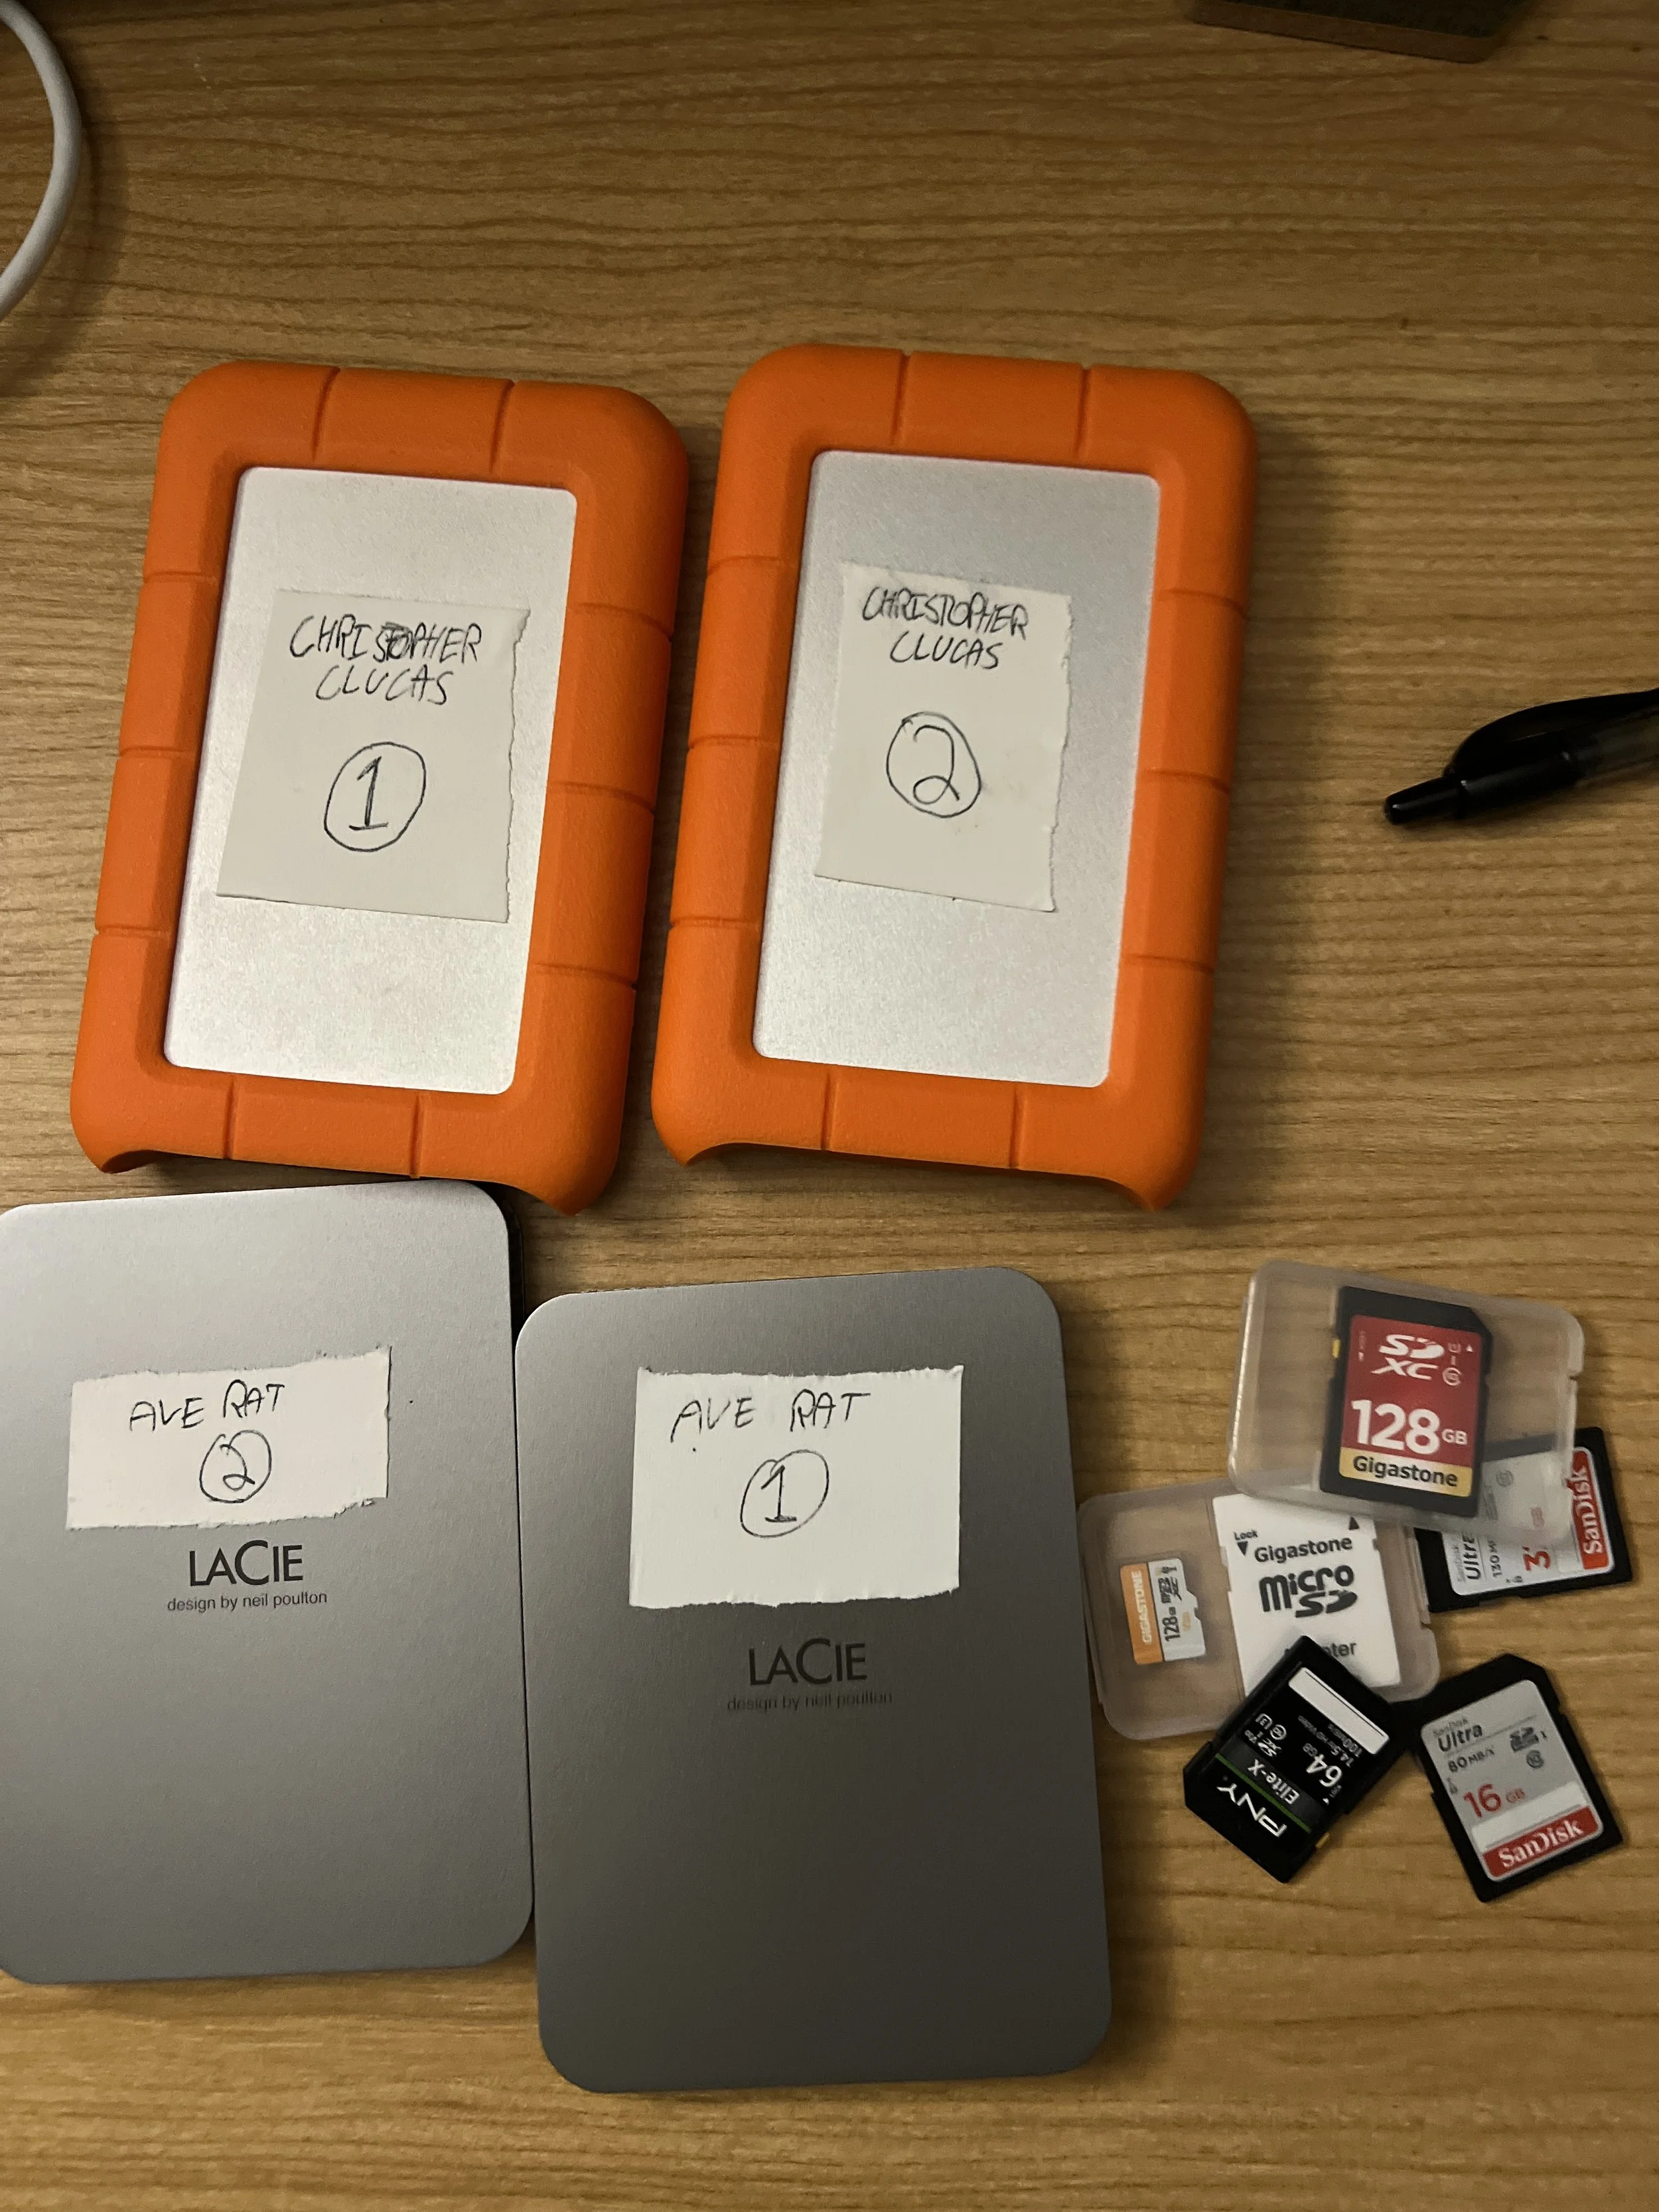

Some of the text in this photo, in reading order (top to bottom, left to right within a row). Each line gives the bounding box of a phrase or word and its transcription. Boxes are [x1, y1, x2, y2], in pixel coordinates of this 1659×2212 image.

[863, 587, 1029, 640] CHRISTOPHER
[890, 630, 1003, 669] CLUCAS
[316, 664, 454, 705] CLUCAS
[912, 725, 960, 804] 2
[349, 757, 389, 830] 1
[129, 1379, 285, 1432] AVE RAT
[670, 1388, 871, 1443] AVE RAT
[1353, 1455, 1458, 1487] Gigastone
[1569, 1465, 1603, 1554] SanDisk
[1234, 1530, 1258, 1540] Lock
[1254, 1537, 1352, 1564] Gigastone
[1522, 1546, 1551, 1572] 3
[167, 1591, 327, 1613] design by neil poulton
[1131, 1570, 1152, 1645] GIGASTONE
[1260, 1565, 1354, 1612] micro
[727, 1690, 893, 1712] design by neil poulton
[1438, 1724, 1482, 1753] Ultra
[1248, 1759, 1300, 1805] Elite-X
[1463, 1783, 1501, 1818] 16
[1217, 1783, 1287, 1838] PNY
[1498, 1818, 1584, 1868] SanDisk
